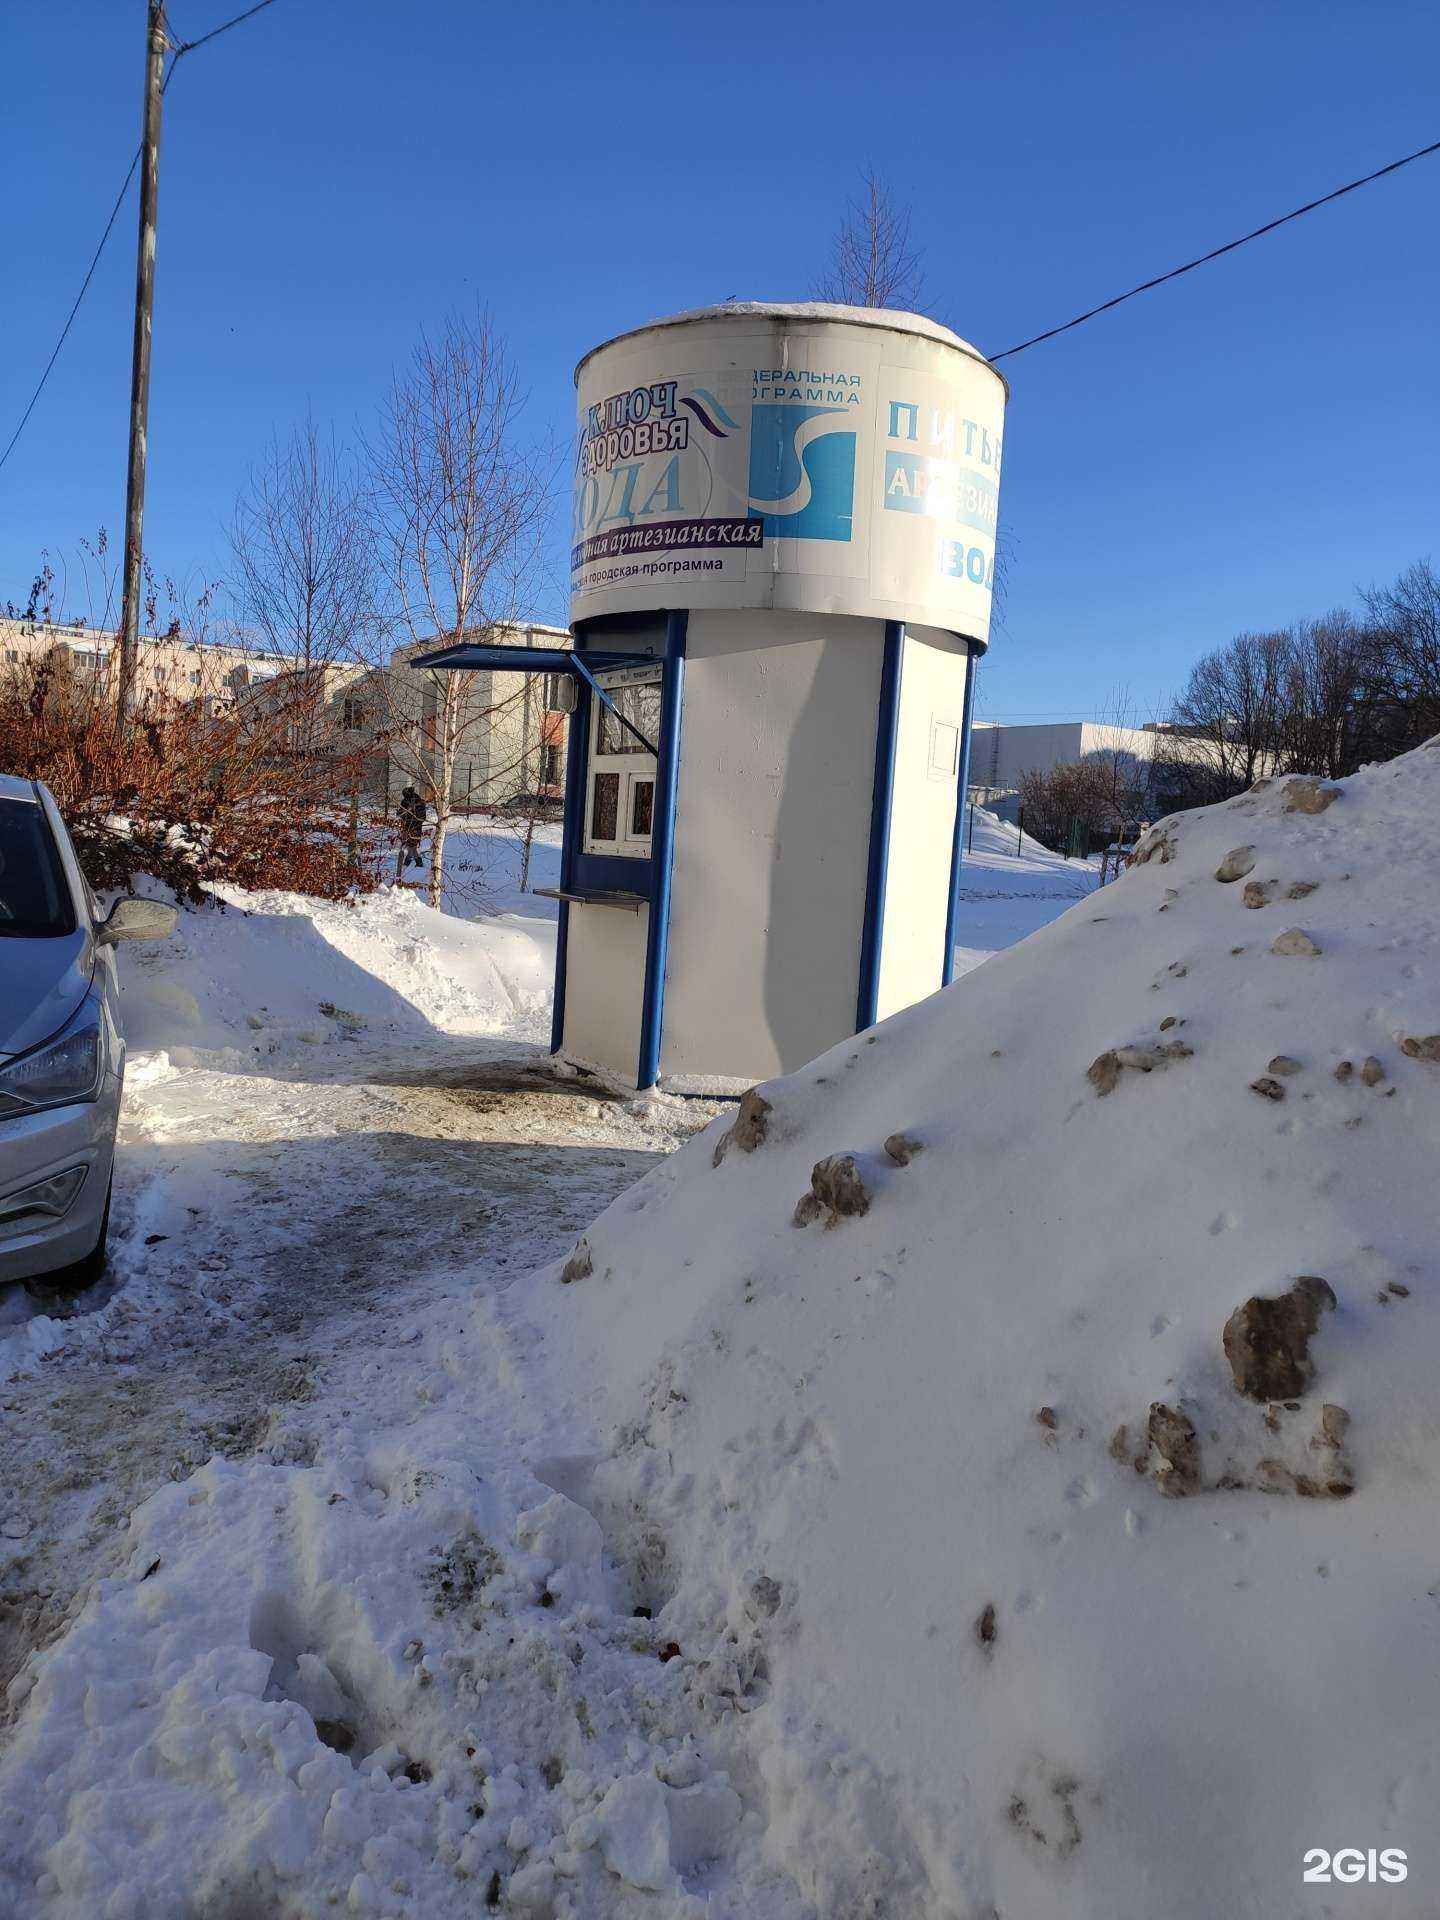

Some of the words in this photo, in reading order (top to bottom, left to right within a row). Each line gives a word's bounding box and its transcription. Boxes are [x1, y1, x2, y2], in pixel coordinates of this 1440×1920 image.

[588, 381, 678, 441] КЛЮЧ
[575, 454, 685, 536] ОДА
[610, 523, 761, 556] артезианская
[590, 565, 639, 584] городская
[642, 559, 724, 577] программа
